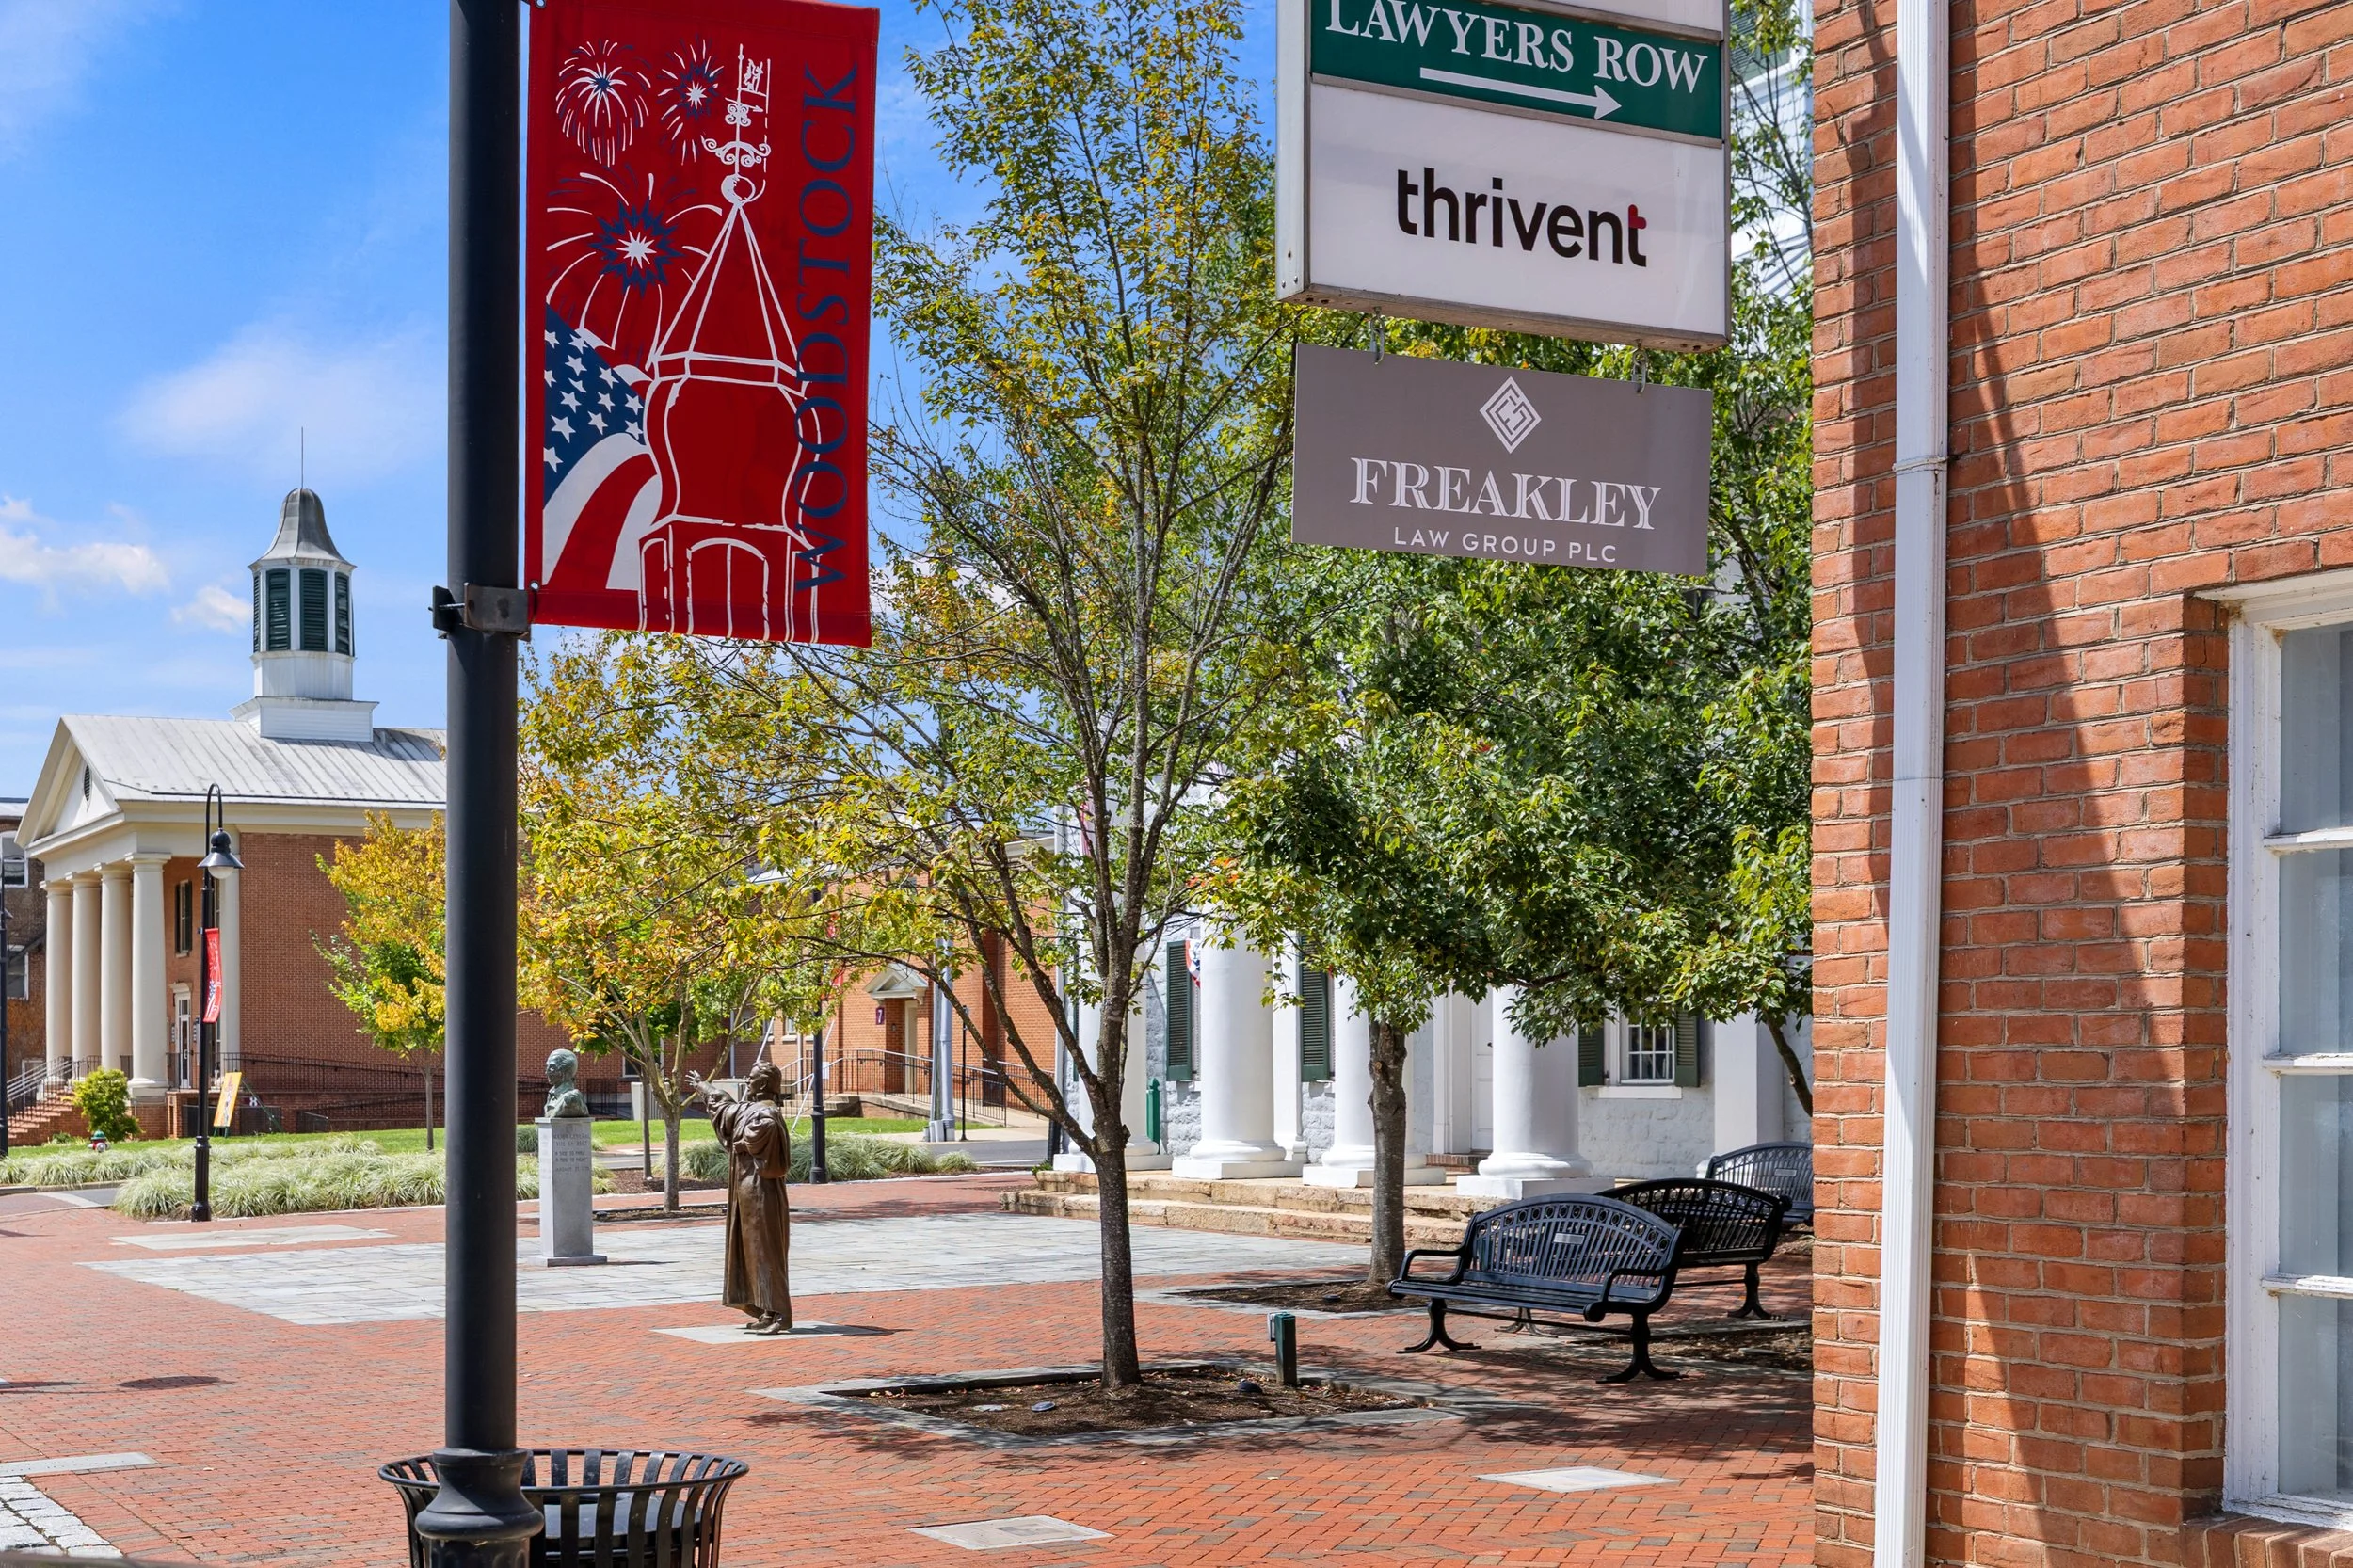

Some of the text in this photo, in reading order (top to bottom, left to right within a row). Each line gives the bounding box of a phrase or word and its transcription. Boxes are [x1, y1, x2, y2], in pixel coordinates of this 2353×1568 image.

[1326, 0, 1708, 94] LAWYERS ROW
[1398, 167, 1647, 267] thrivent
[793, 60, 858, 591] WOODSTOCK
[1350, 456, 1662, 530] FREAKLEY
[1394, 526, 1617, 563] LAW GROUP PLC
[877, 1009, 883, 1023] 7
[249, 1096, 258, 1107] 8
